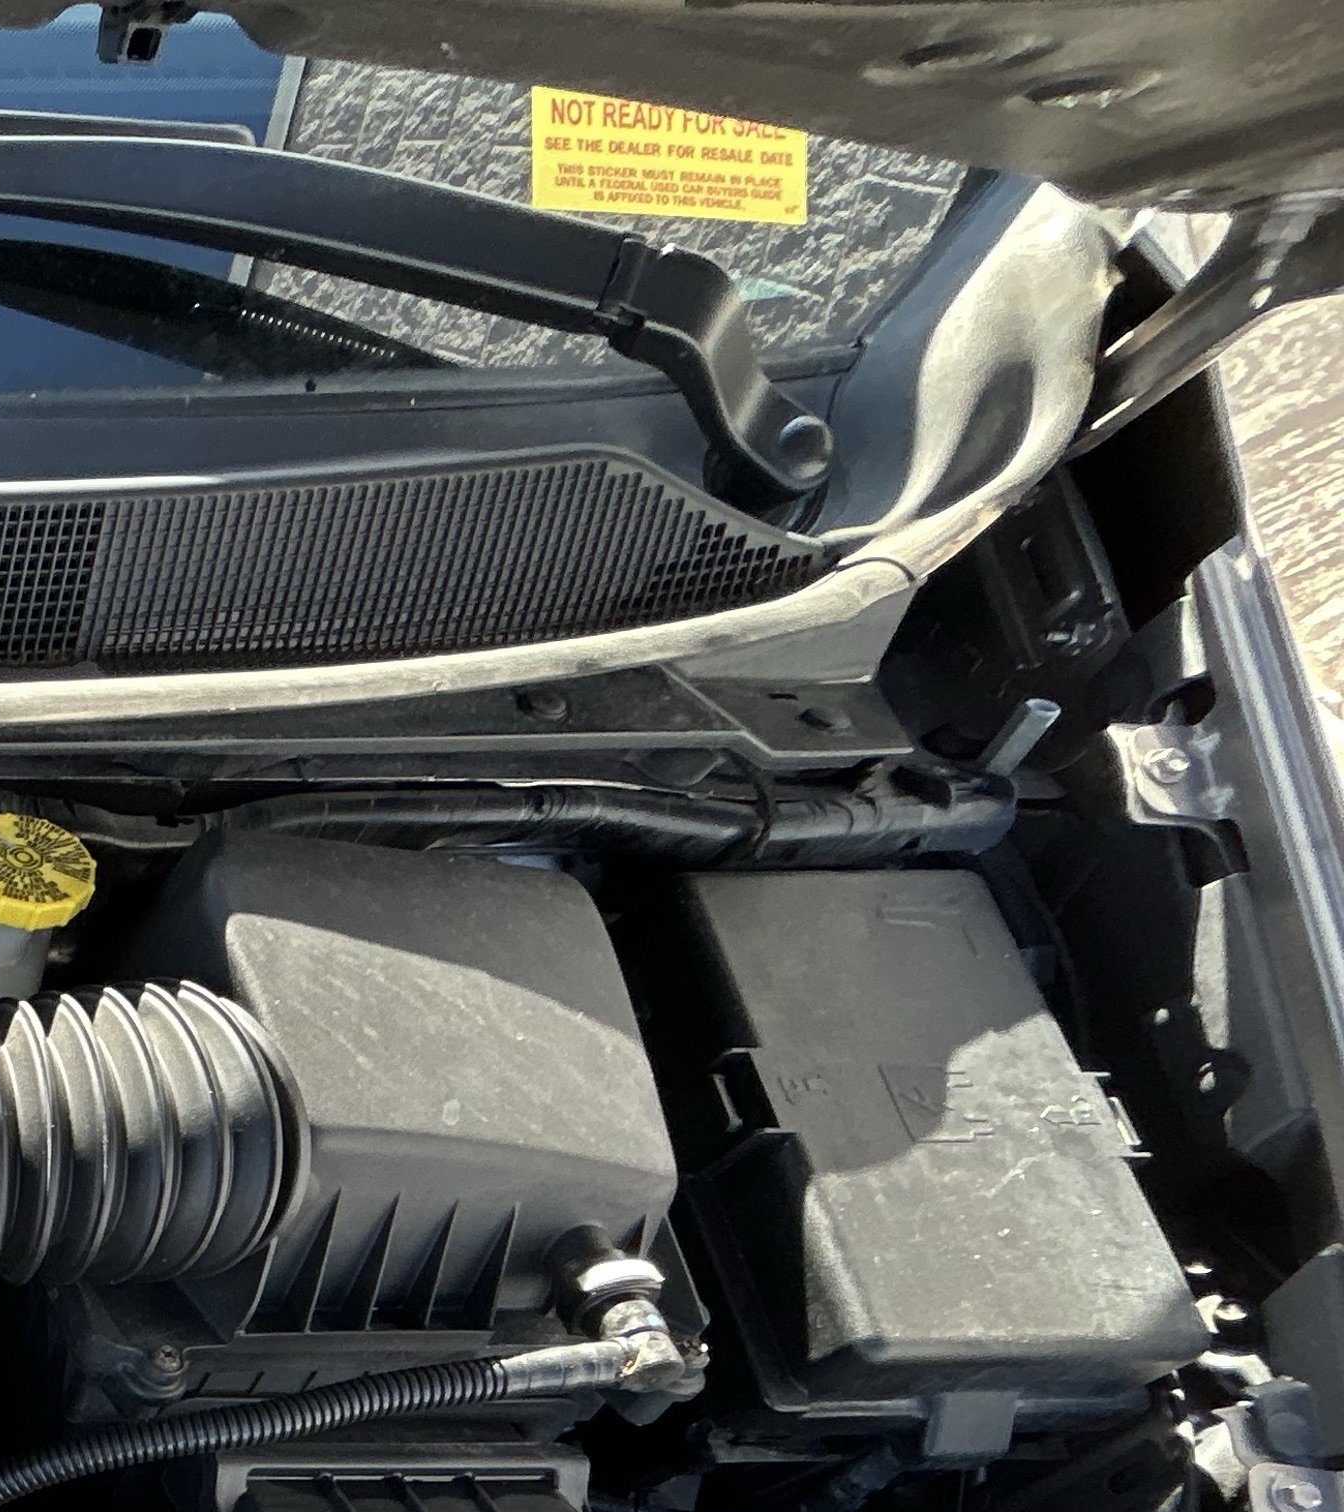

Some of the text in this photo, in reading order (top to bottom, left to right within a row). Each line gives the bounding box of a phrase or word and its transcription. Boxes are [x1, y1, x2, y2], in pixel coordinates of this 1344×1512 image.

[551, 98, 595, 126] NOT
[602, 101, 675, 132] READY
[682, 111, 726, 135] FOR
[544, 137, 793, 167] SEE THE DEALER FOR RESALE DATE
[555, 176, 586, 188] UNTIL
[588, 178, 596, 188] A
[600, 179, 648, 191] FEDERAL
[651, 181, 679, 193] USED
[682, 183, 703, 194] CAR
[557, 163, 783, 188] THIS STICKER MUST REMAIN IN PLACE
[594, 191, 604, 201] IS
[607, 191, 653, 204] AFFIXED
[656, 194, 670, 205] TO
[672, 195, 696, 207] THIS
